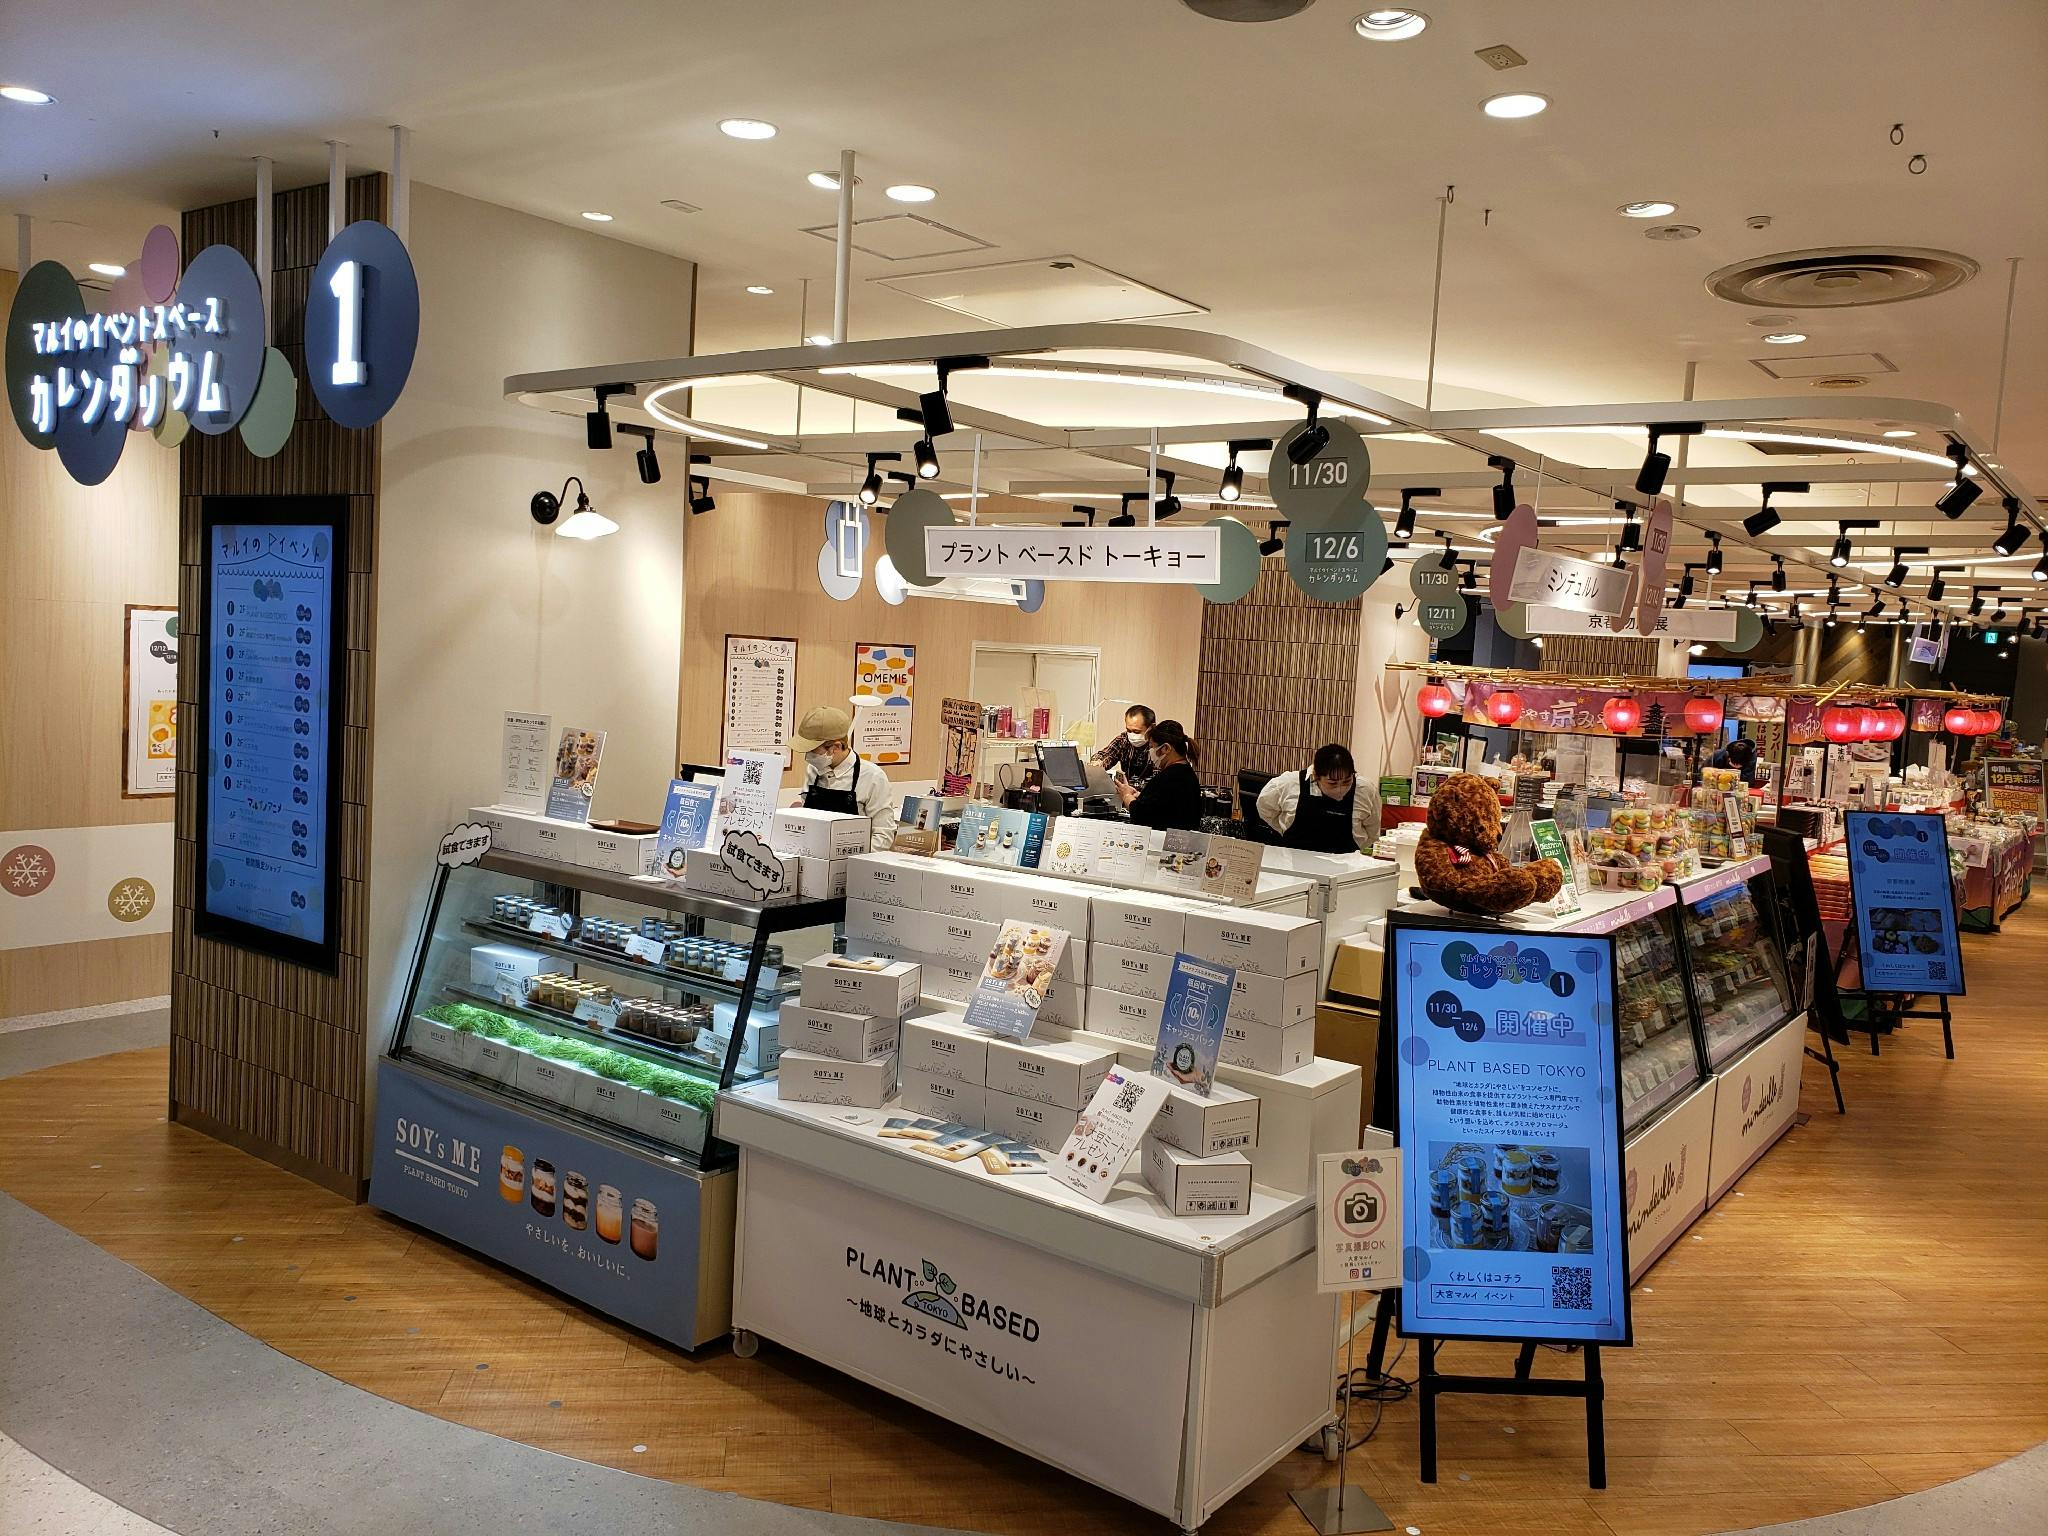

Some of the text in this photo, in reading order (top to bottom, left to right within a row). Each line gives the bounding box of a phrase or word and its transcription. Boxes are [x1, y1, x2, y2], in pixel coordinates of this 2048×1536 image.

[32, 297, 221, 355] マルイのイベントスペース
[329, 260, 367, 386] 1
[31, 347, 228, 433] カレンダリウム
[1291, 461, 1348, 486] 11/30
[941, 542, 1206, 568] プラント ベースド トーキョー
[1313, 536, 1359, 560] 12/6
[1419, 573, 1449, 585] 11/30
[1547, 566, 1600, 600] ミンデュルレ
[1428, 607, 1455, 620] 12/11
[863, 672, 907, 684] OMEMIE
[441, 834, 490, 857] 試食できます
[726, 841, 780, 882] 試食できます
[1240, 934, 1252, 943] ME
[1459, 963, 1541, 980] カレンダリウム
[1559, 975, 1566, 994] 1
[1429, 1002, 1457, 1014] 11/30
[1165, 1022, 1215, 1047] キャッシュバック
[1461, 1021, 1478, 1032] 12/6
[1495, 1008, 1574, 1038] 開催中
[1428, 1059, 1586, 1078] PLANT BASED TOKYO
[396, 1117, 481, 1175] SOY's ME
[1090, 1127, 1126, 1153] 大豆ミート
[403, 1164, 469, 1199] PLANT BASED TOKYO
[1335, 1240, 1386, 1253] 写真撮影OK
[1449, 1271, 1522, 1284] くわしくはコチラ
[846, 1246, 1040, 1343] PLANT BASED
[1435, 1290, 1515, 1300] 大宮マルイ イベント
[922, 1301, 949, 1318] TOKYO
